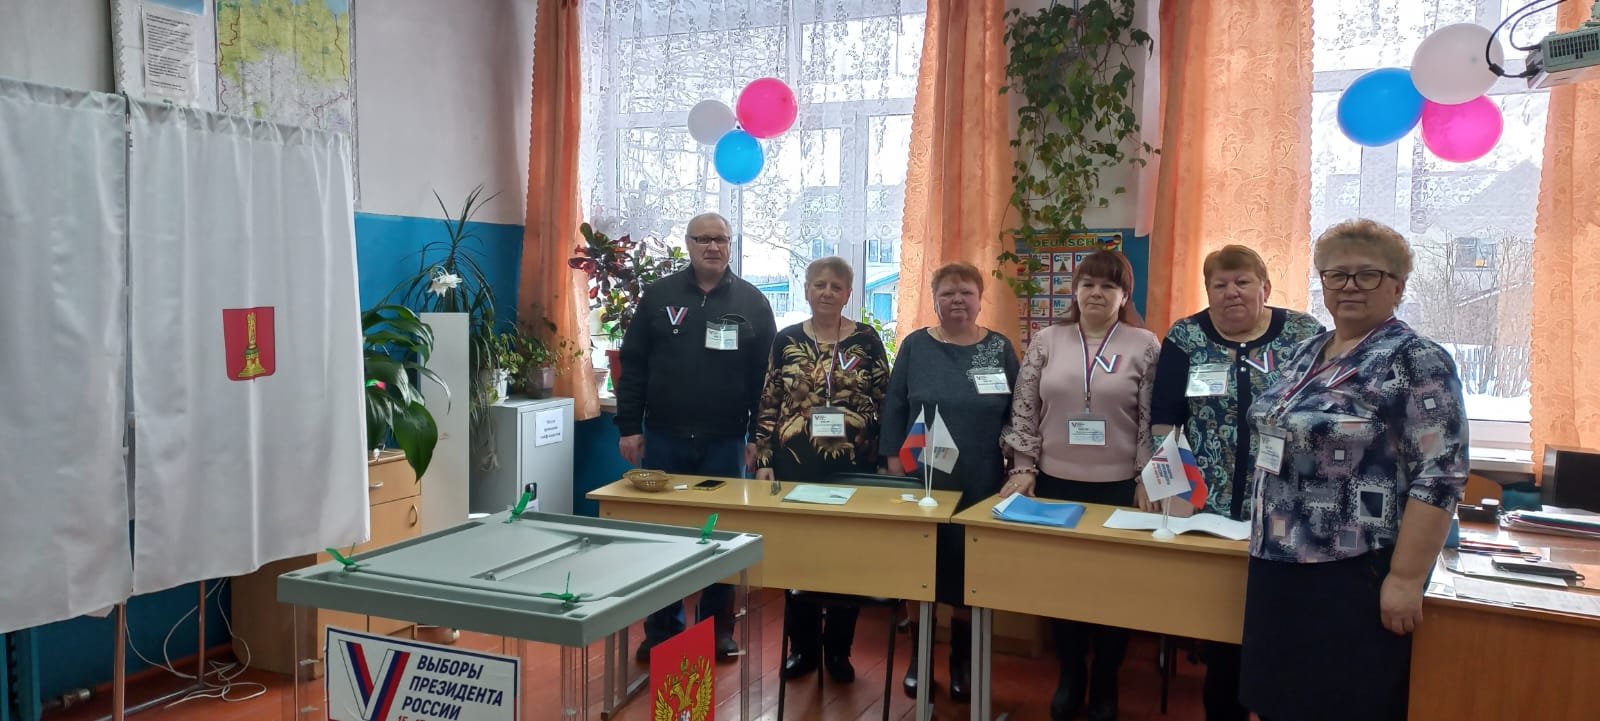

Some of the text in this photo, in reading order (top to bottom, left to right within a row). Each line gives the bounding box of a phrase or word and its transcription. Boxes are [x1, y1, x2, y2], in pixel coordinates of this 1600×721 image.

[416, 654, 484, 680] ВЫБОРЫ
[408, 675, 504, 707] ПРЕЗИДЕНТА
[401, 696, 462, 720] РОССИИ
